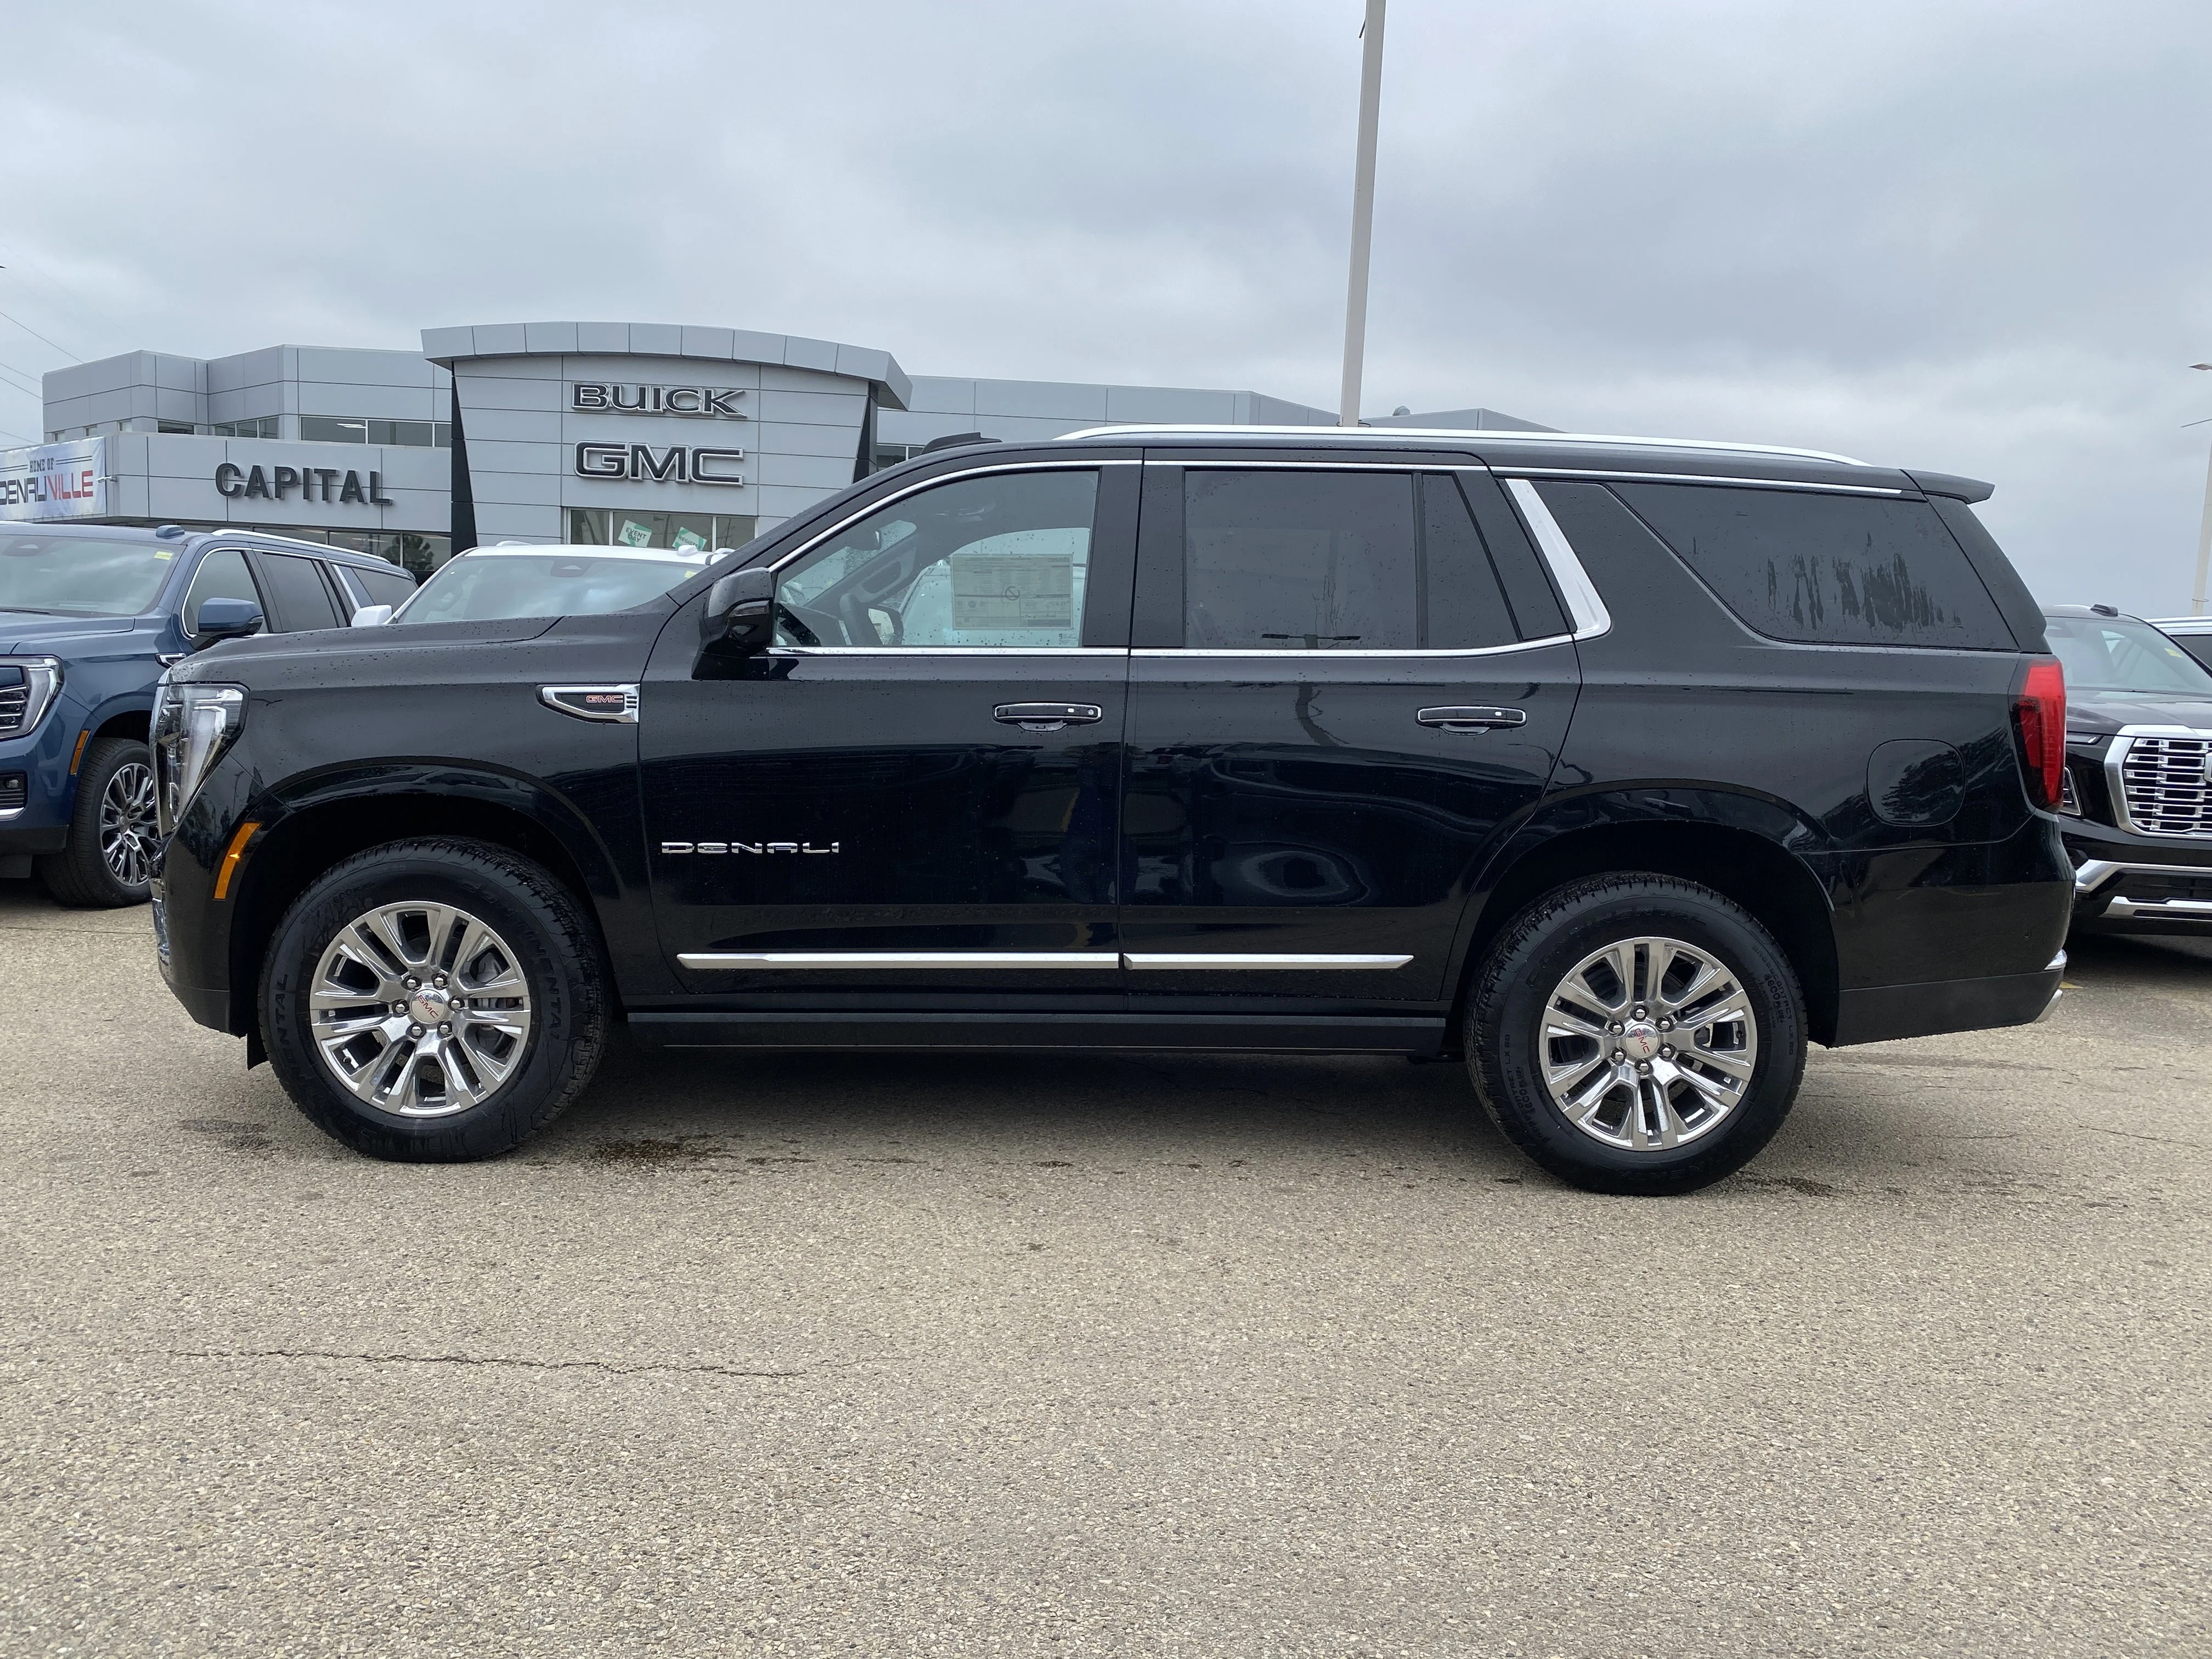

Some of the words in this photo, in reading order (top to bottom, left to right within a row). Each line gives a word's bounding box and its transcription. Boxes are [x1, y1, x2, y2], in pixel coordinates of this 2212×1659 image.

[572, 382, 747, 418] BUICK
[30, 459, 46, 473] HOME
[47, 458, 54, 471] OF
[574, 441, 744, 487] GMC
[215, 462, 393, 505] CAPITAL
[625, 527, 647, 540] EVENT
[628, 533, 641, 543] DAY
[586, 695, 624, 703] GMC
[662, 842, 839, 854] DENALI
[417, 995, 439, 1019] GMC
[1635, 1028, 1650, 1054] GMC
